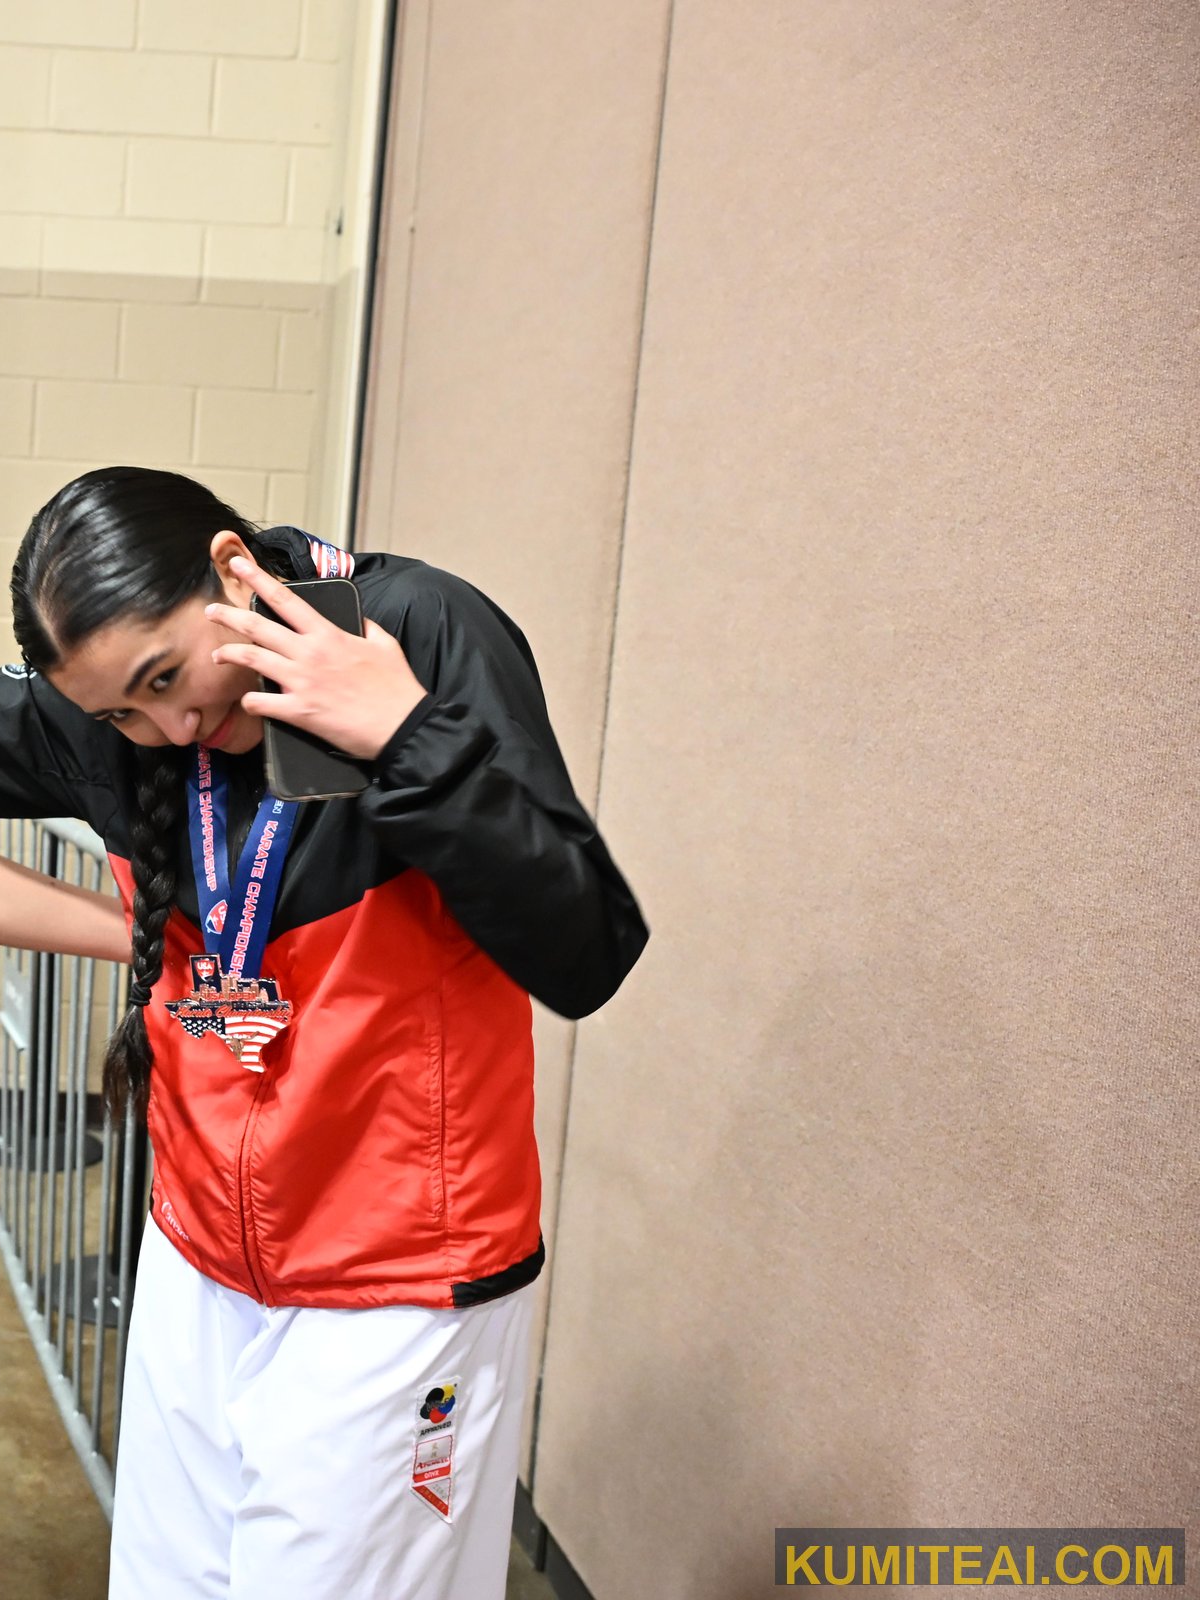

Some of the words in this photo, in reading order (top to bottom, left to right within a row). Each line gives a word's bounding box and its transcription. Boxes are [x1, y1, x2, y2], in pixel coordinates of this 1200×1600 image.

[199, 790, 217, 892] CHAMPIONSHIP
[251, 820, 279, 879] KARATE
[228, 881, 261, 979] CHAMPIONSH
[197, 961, 212, 971] USA
[420, 1421, 452, 1436] APPROVED
